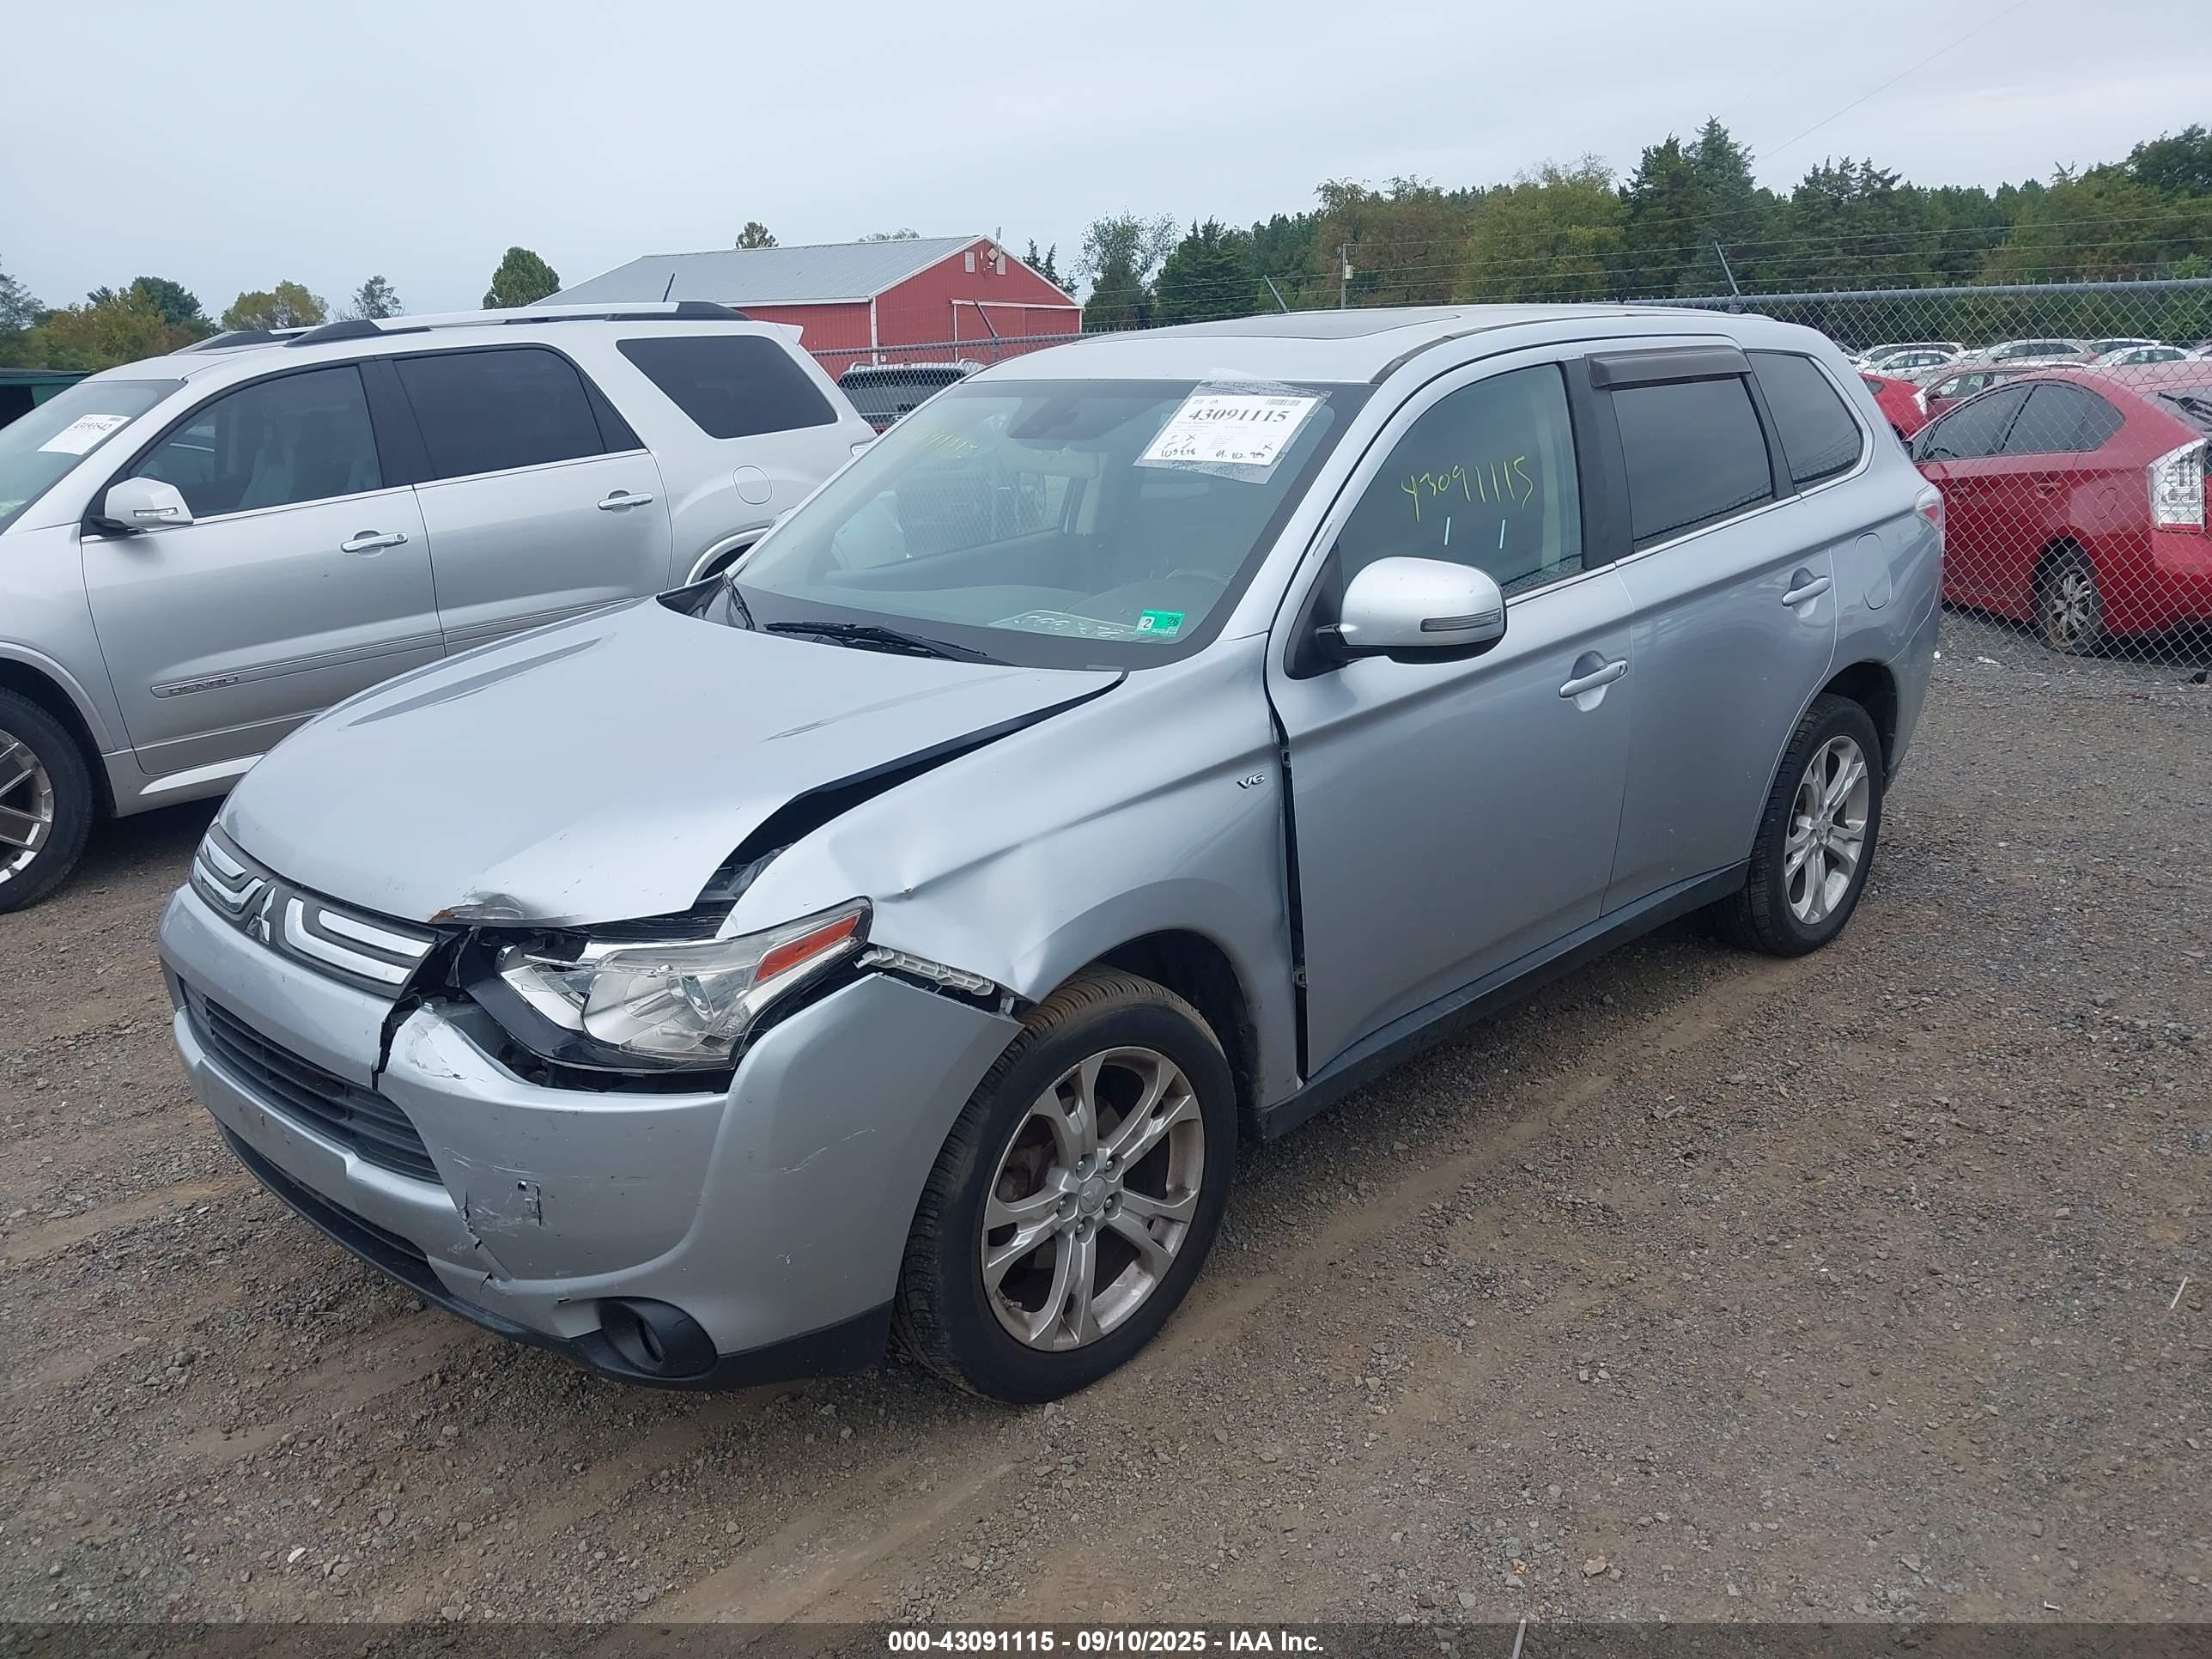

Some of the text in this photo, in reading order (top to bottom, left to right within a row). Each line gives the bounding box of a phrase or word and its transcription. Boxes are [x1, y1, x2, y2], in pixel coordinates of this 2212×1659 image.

[1188, 408, 1291, 422] 43091115
[1401, 455, 1534, 523] 43091115
[1143, 618, 1152, 629] 2
[168, 675, 240, 696] DENALI
[1236, 771, 1265, 790] V6
